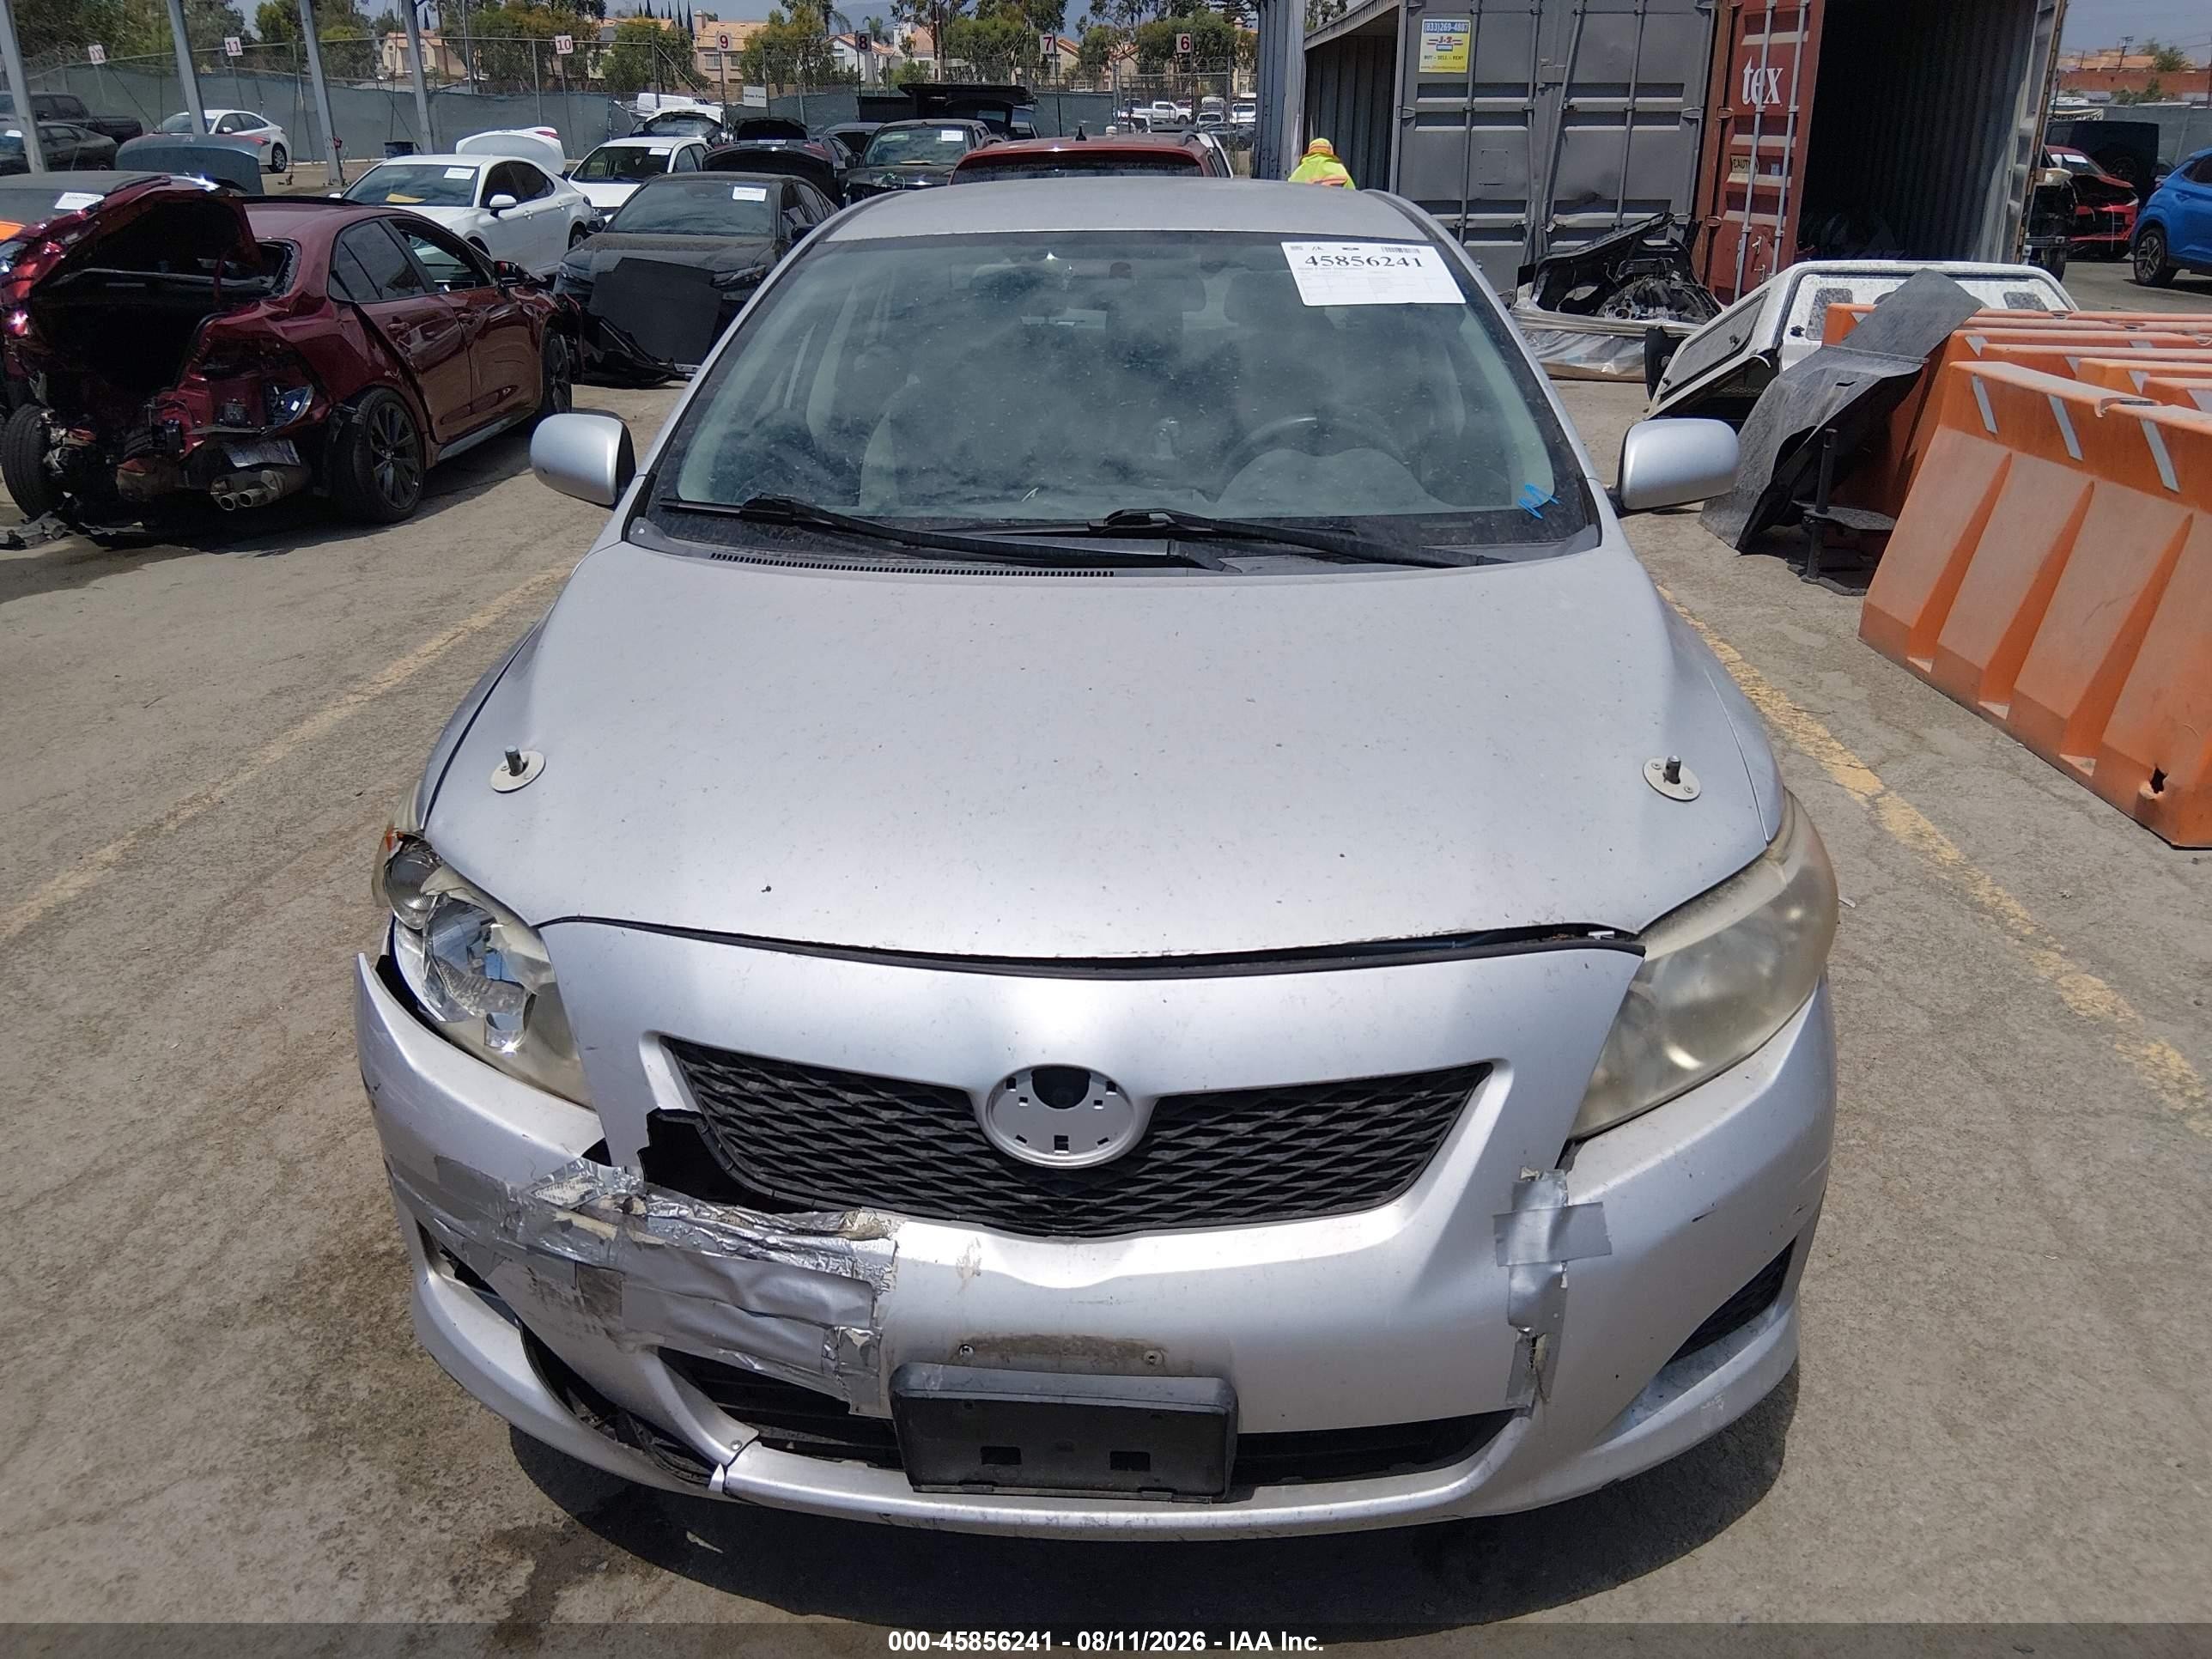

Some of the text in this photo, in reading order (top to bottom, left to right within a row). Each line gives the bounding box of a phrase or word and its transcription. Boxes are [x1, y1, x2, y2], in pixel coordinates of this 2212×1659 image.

[226, 40, 241, 53] 11
[556, 39, 572, 51] 10
[720, 34, 729, 49] 9
[859, 35, 868, 50] 8
[1042, 36, 1053, 52] 7
[1181, 35, 1190, 51] 6
[1741, 56, 1784, 105] tex
[1304, 255, 1423, 268] 45856241
